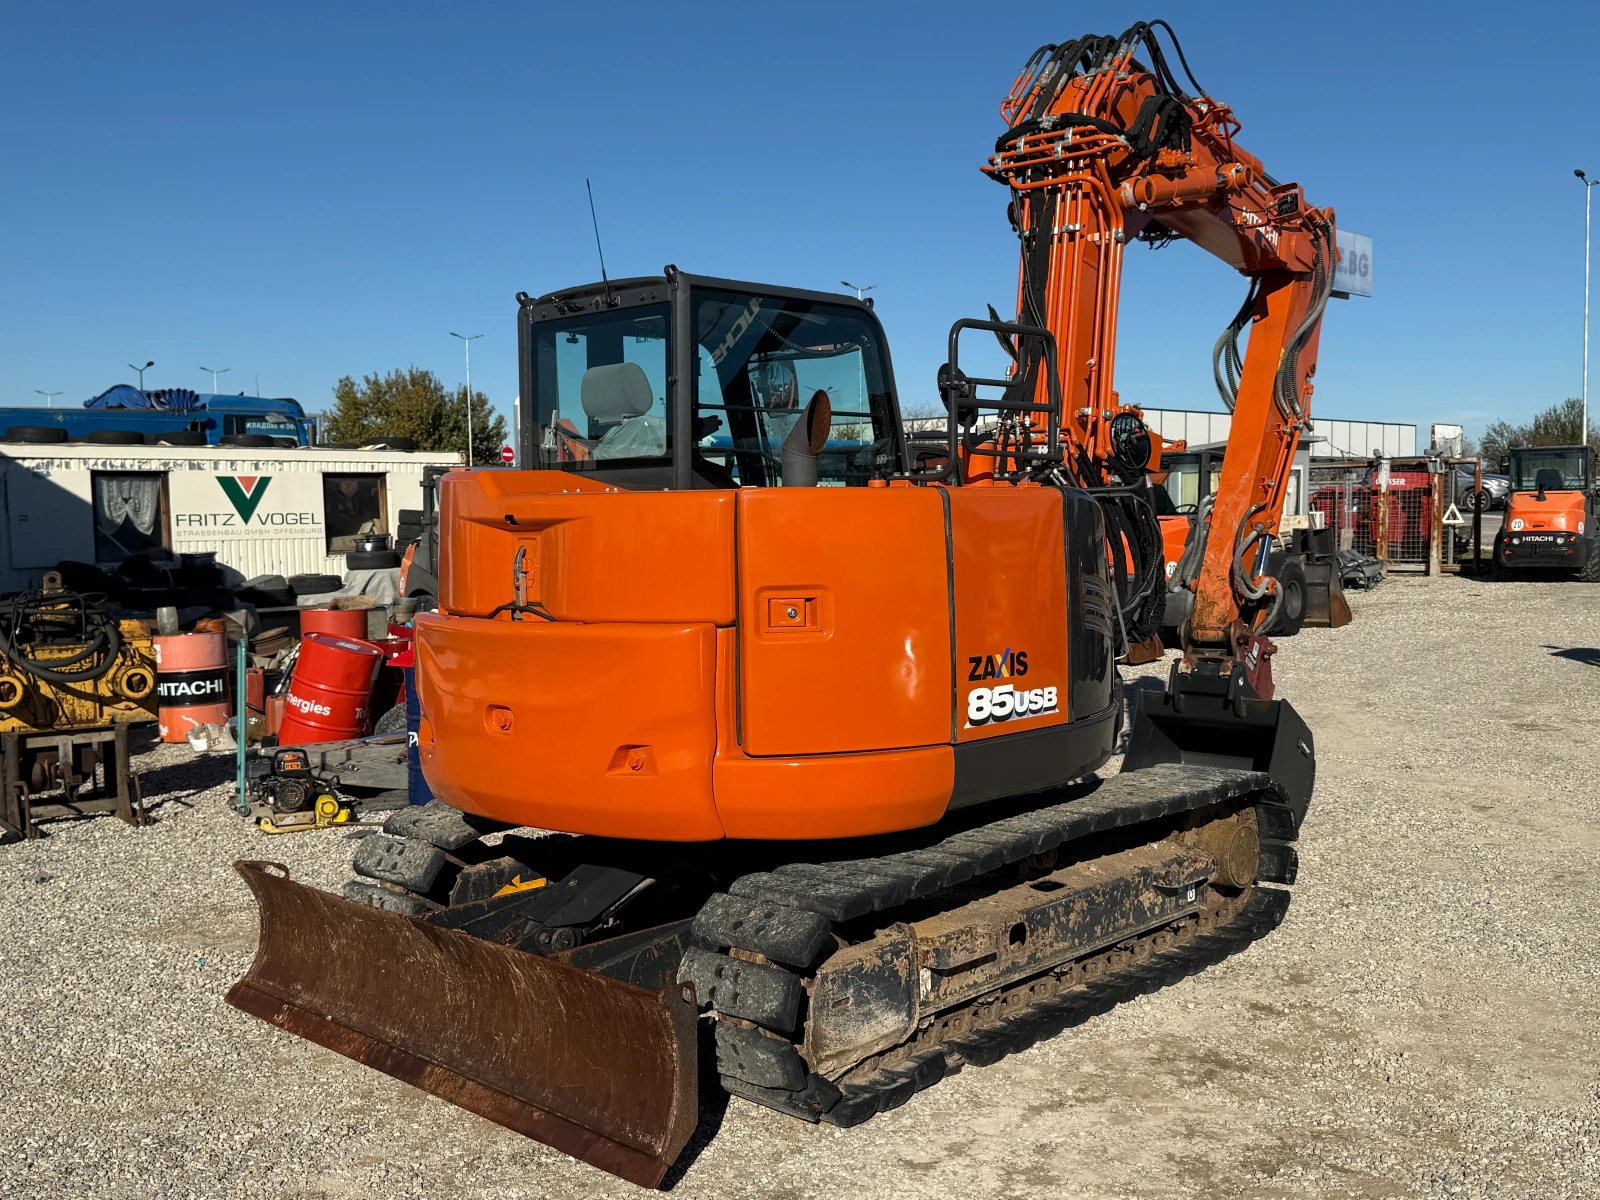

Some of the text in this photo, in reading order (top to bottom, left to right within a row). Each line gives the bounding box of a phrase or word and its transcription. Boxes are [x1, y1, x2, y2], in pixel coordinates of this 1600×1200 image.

[176, 512, 321, 527] FRITZ VOGEL
[1513, 520, 1522, 529] 20
[176, 529, 242, 537] STRASSENBAU
[273, 527, 323, 535] OFFENBURG
[968, 647, 1028, 682] ZAXIS
